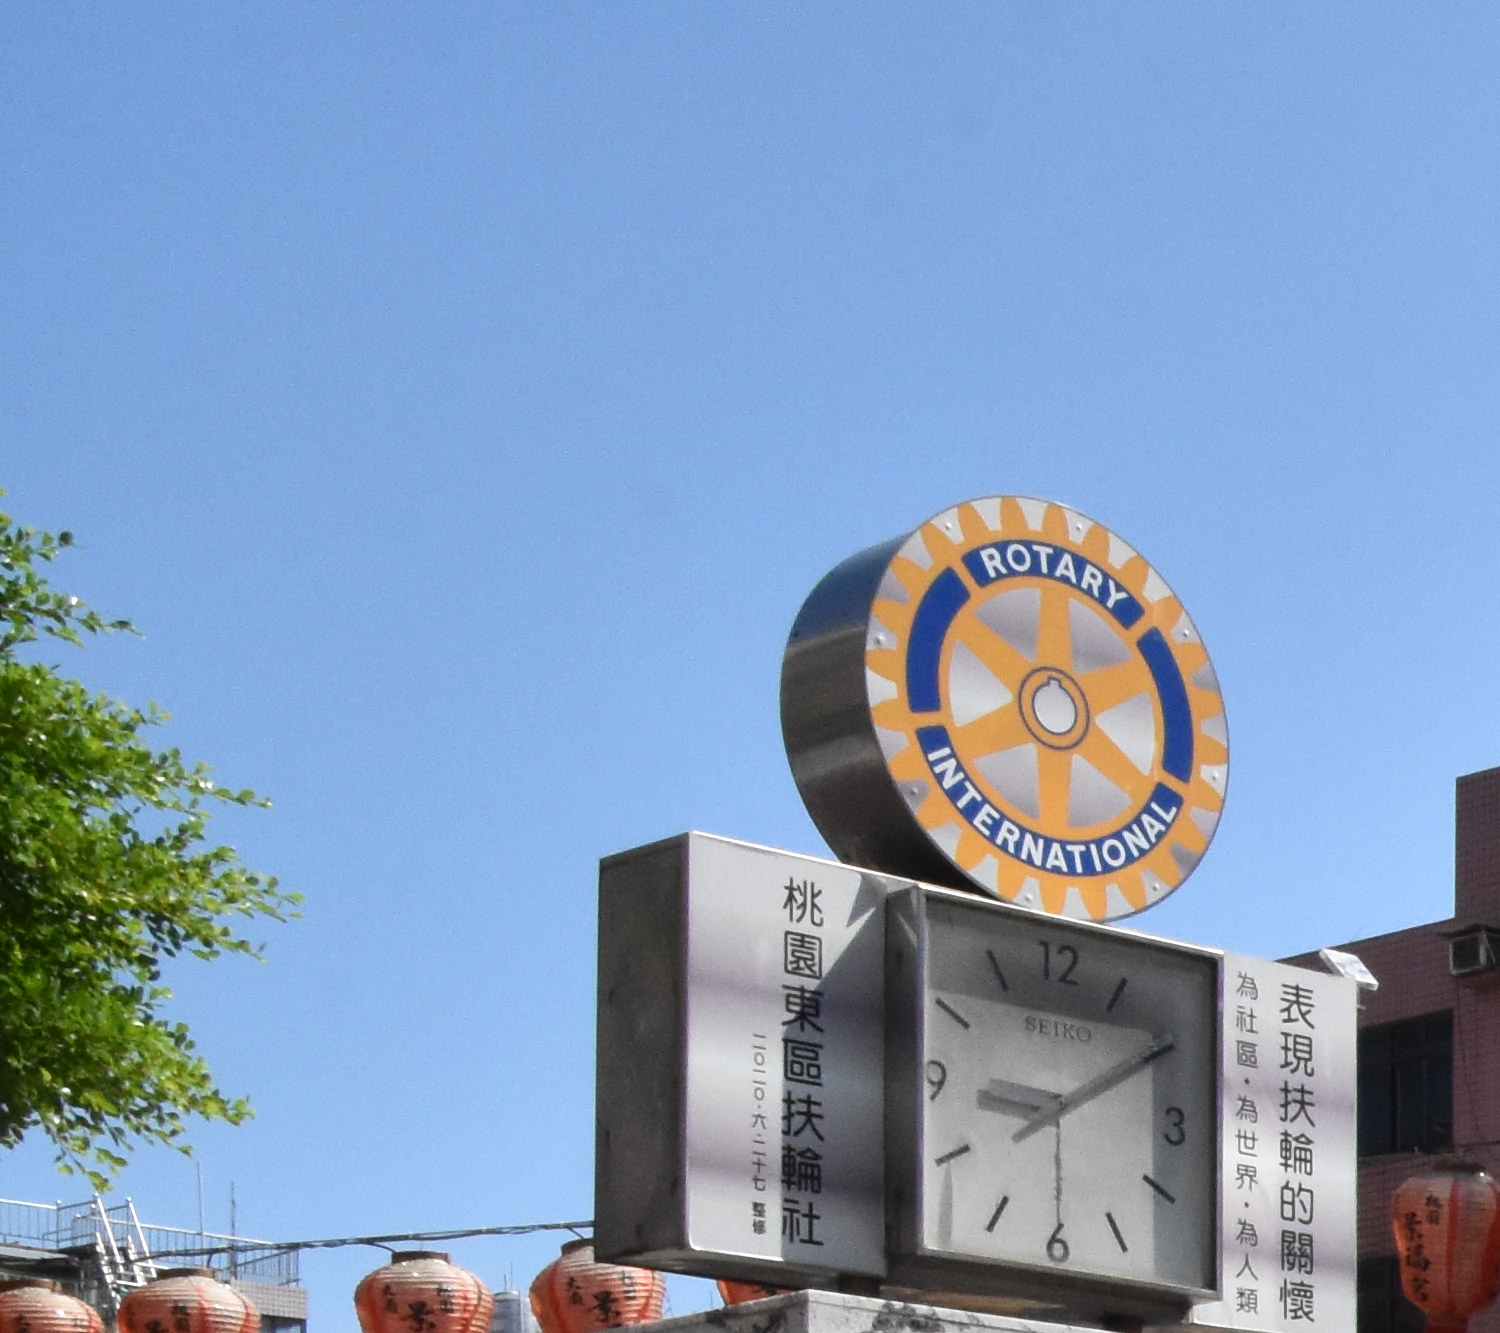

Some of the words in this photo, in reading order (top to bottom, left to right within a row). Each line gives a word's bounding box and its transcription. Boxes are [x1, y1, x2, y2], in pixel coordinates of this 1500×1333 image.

[981, 543, 1129, 611] ROTARY
[925, 745, 1180, 877] INTERNATIONAL
[1038, 942, 1079, 986] 12
[1024, 1016, 1093, 1042] SEIKO
[780, 877, 825, 1248] 桃園東區扶輪社
[926, 1060, 947, 1101] 9
[1165, 1107, 1186, 1146] 3
[1279, 982, 1315, 1324] 表現扶輪的關懷
[1047, 1222, 1070, 1263] 6
